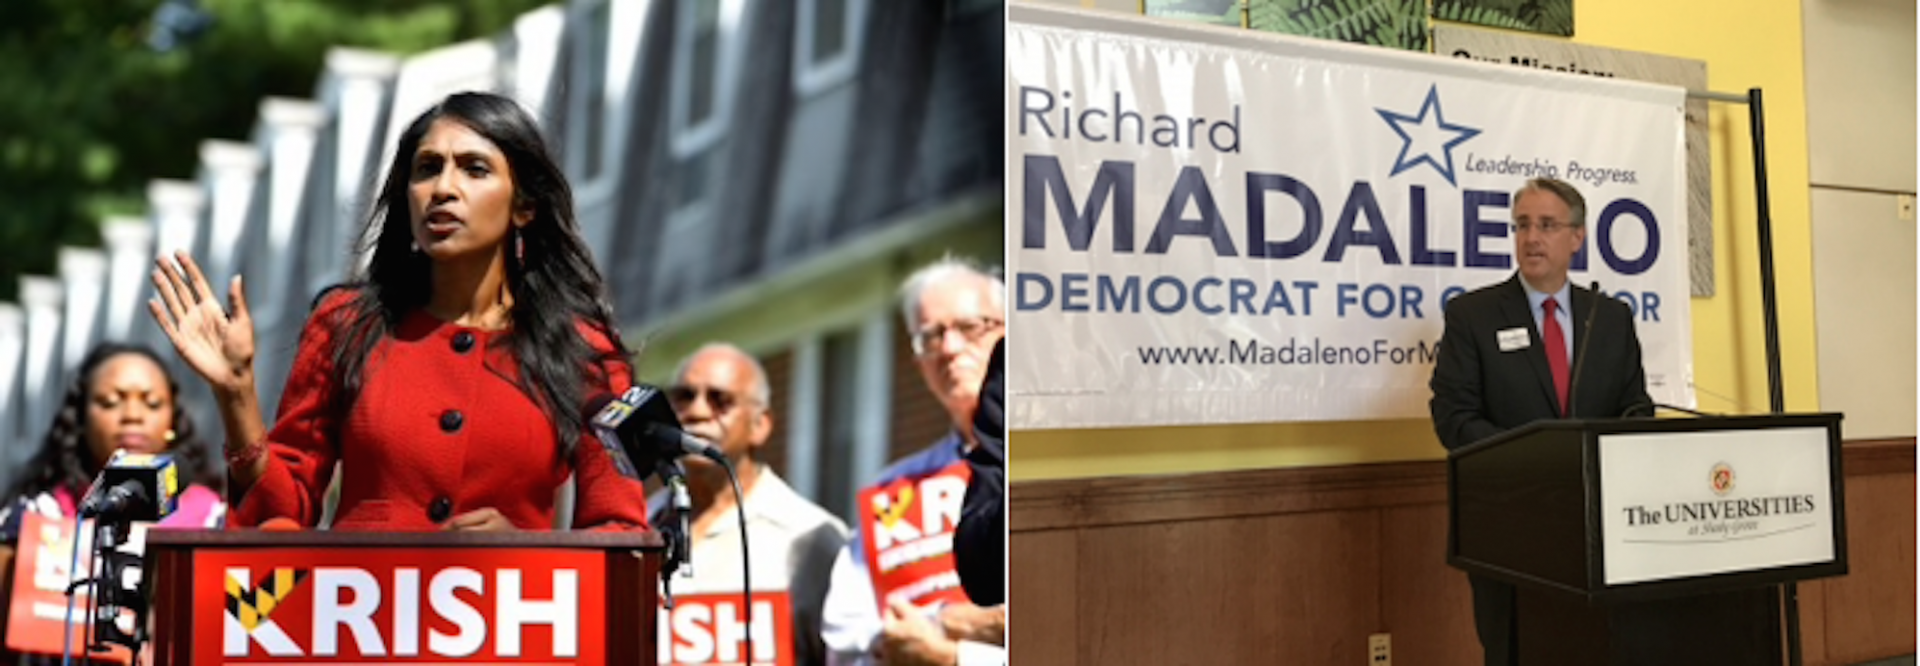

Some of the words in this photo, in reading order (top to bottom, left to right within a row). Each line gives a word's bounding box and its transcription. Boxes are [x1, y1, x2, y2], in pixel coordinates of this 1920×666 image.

[1018, 85, 1241, 154] Richard
[1464, 153, 1561, 180] Leadership.
[1566, 161, 1639, 186] Progress.
[1015, 272, 1319, 318] DEMOCRAT
[1336, 283, 1425, 319] FOR
[1623, 505, 1662, 527] The
[1664, 494, 1816, 524] UNIVERSITIES
[222, 567, 579, 658] KRISH
